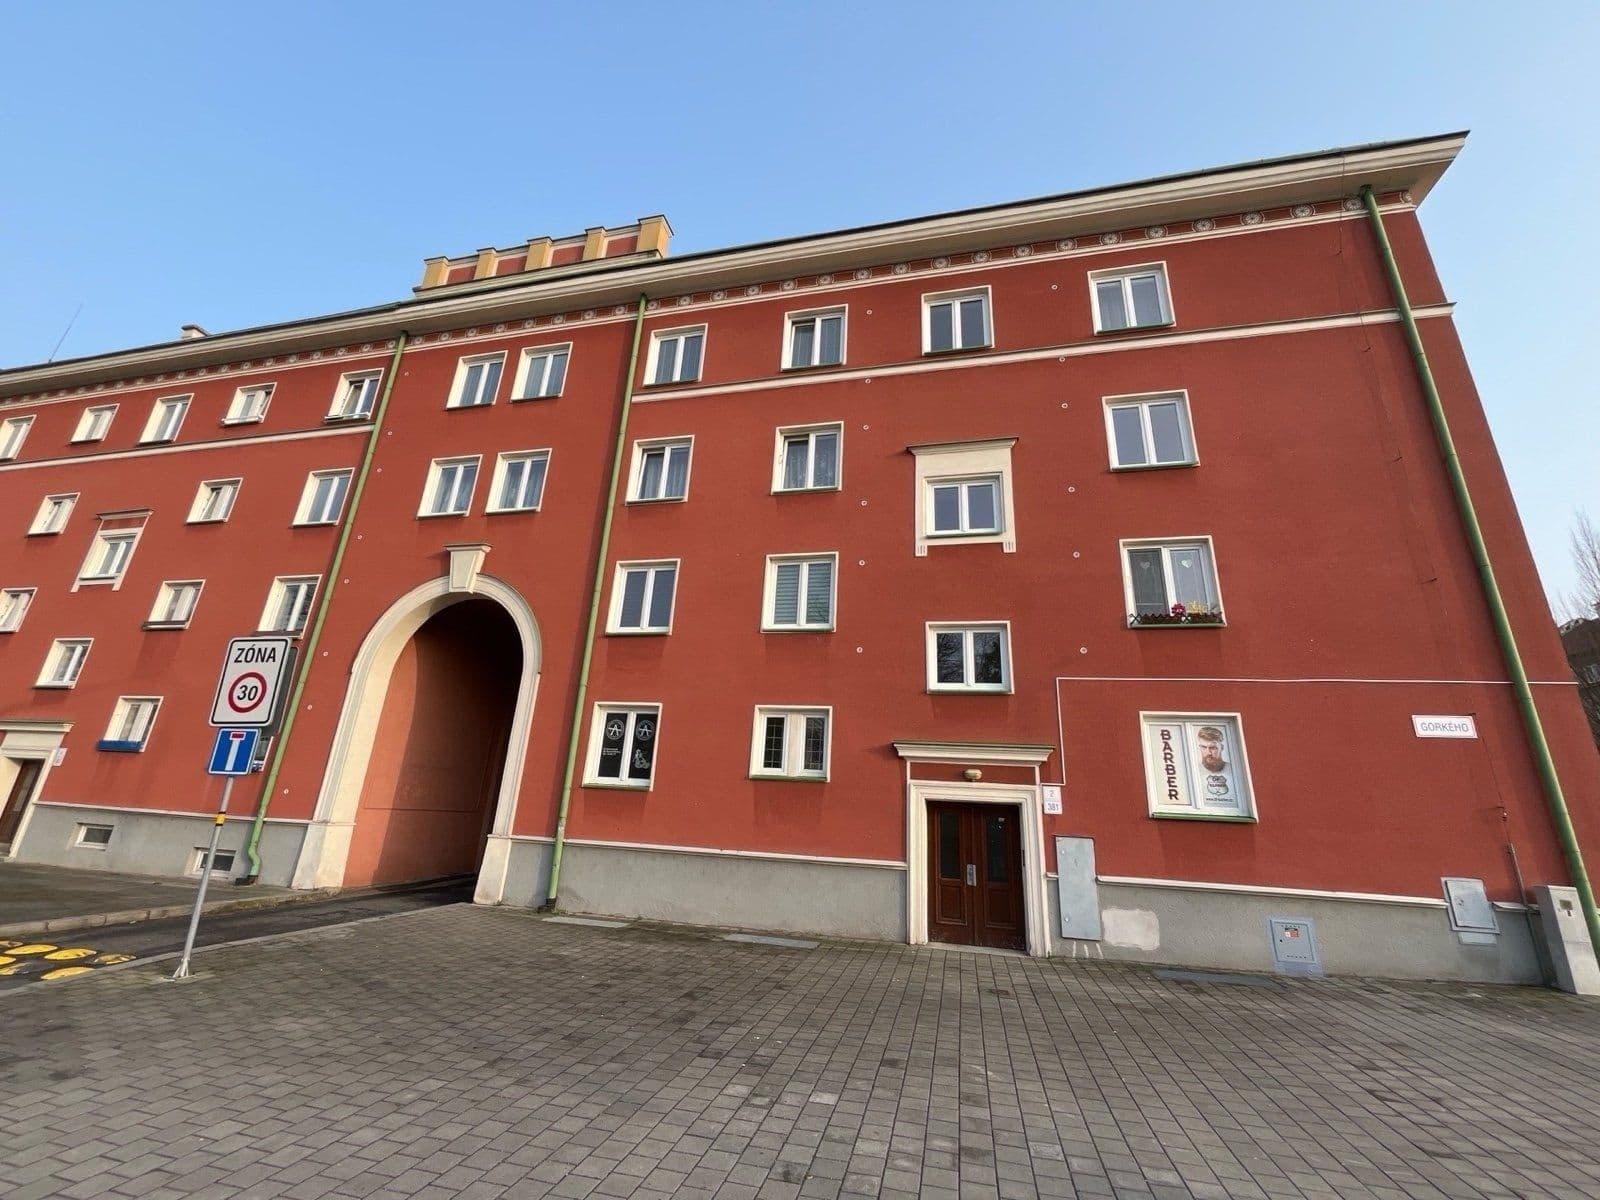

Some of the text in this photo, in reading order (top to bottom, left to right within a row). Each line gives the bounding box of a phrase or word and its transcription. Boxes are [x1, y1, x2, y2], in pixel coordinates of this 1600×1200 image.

[234, 644, 276, 663] ZÓNA
[237, 685, 258, 701] 30
[1420, 721, 1469, 732] GORKÉHO
[1160, 729, 1179, 801] BARBER
